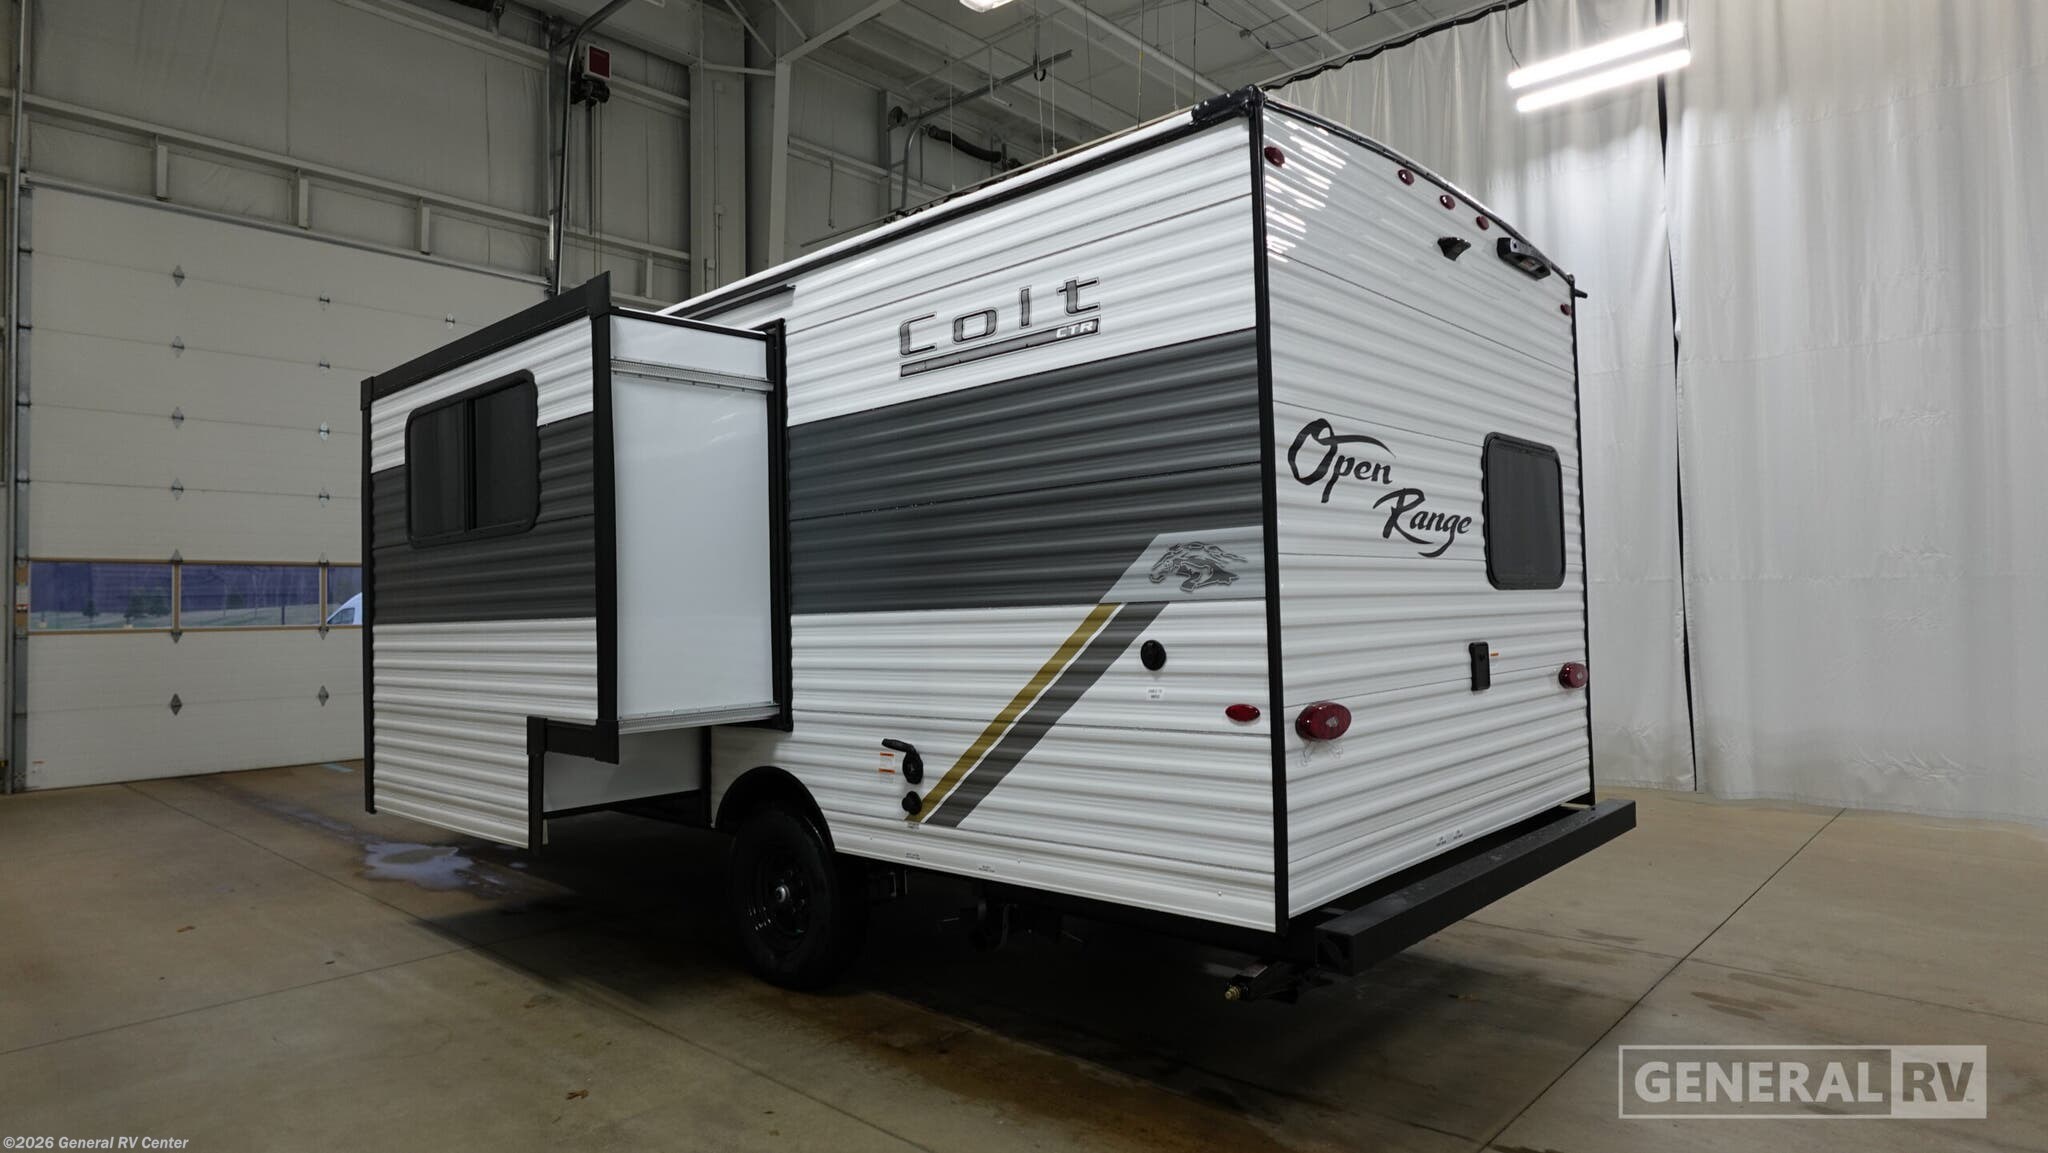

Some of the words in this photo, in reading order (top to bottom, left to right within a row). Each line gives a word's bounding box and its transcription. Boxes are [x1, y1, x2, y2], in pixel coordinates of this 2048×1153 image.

[1056, 320, 1095, 339] CTR
[1288, 418, 1396, 503] Open
[1373, 488, 1472, 557] Range
